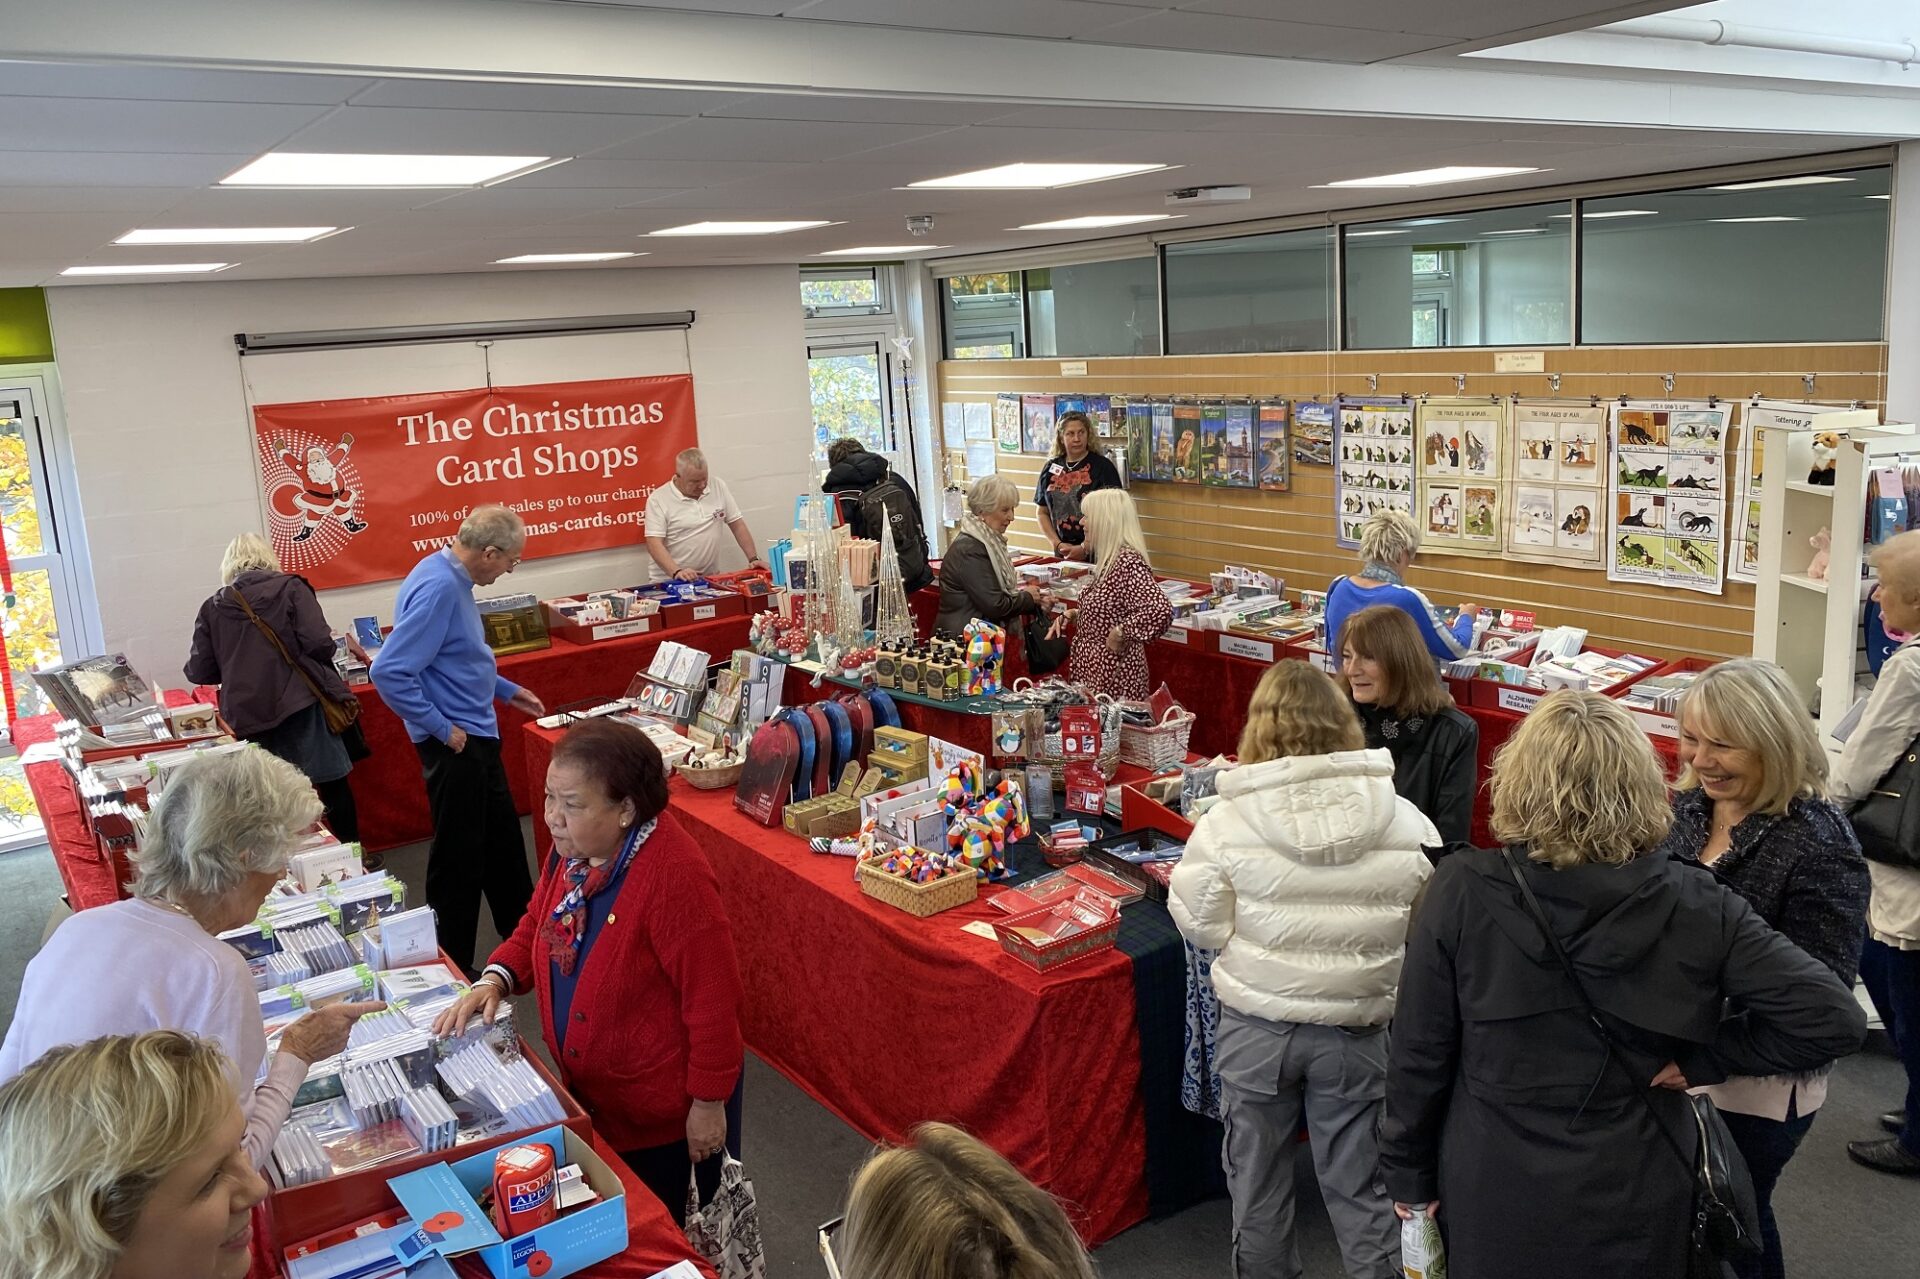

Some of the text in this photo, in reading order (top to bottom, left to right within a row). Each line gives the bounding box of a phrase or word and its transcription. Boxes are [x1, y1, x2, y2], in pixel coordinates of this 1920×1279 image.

[397, 401, 664, 446] The Christmas
[436, 442, 639, 486] Card Shops
[409, 509, 450, 527] 100%
[453, 505, 469, 521] of
[508, 499, 544, 514] sales
[547, 497, 563, 512] go
[566, 495, 581, 506] to
[584, 492, 609, 504] our
[1505, 699, 1533, 711] RESEARC
[513, 1246, 535, 1260] LEGION
